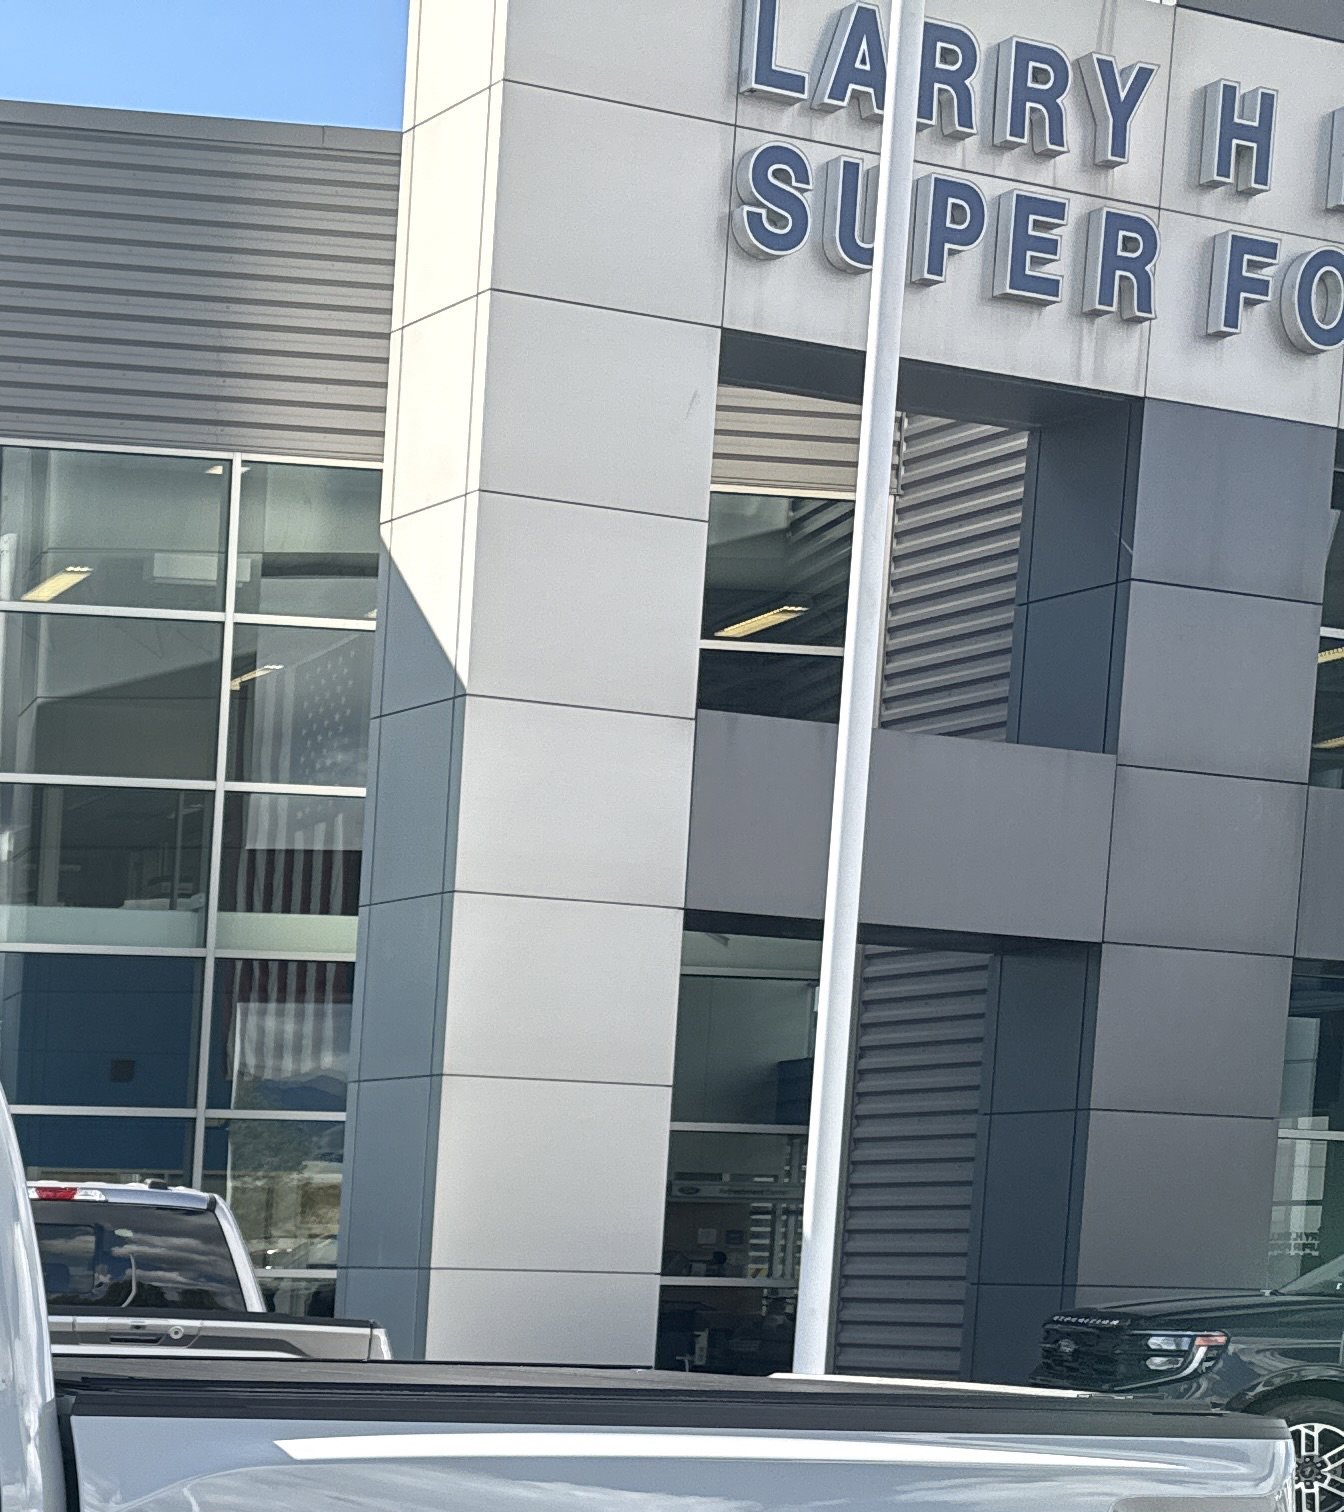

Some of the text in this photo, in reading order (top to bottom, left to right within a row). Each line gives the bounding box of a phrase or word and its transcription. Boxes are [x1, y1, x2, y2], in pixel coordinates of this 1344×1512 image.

[739, 0, 1160, 168] LARRY
[1200, 78, 1279, 195] H
[732, 140, 1161, 323] SUPER
